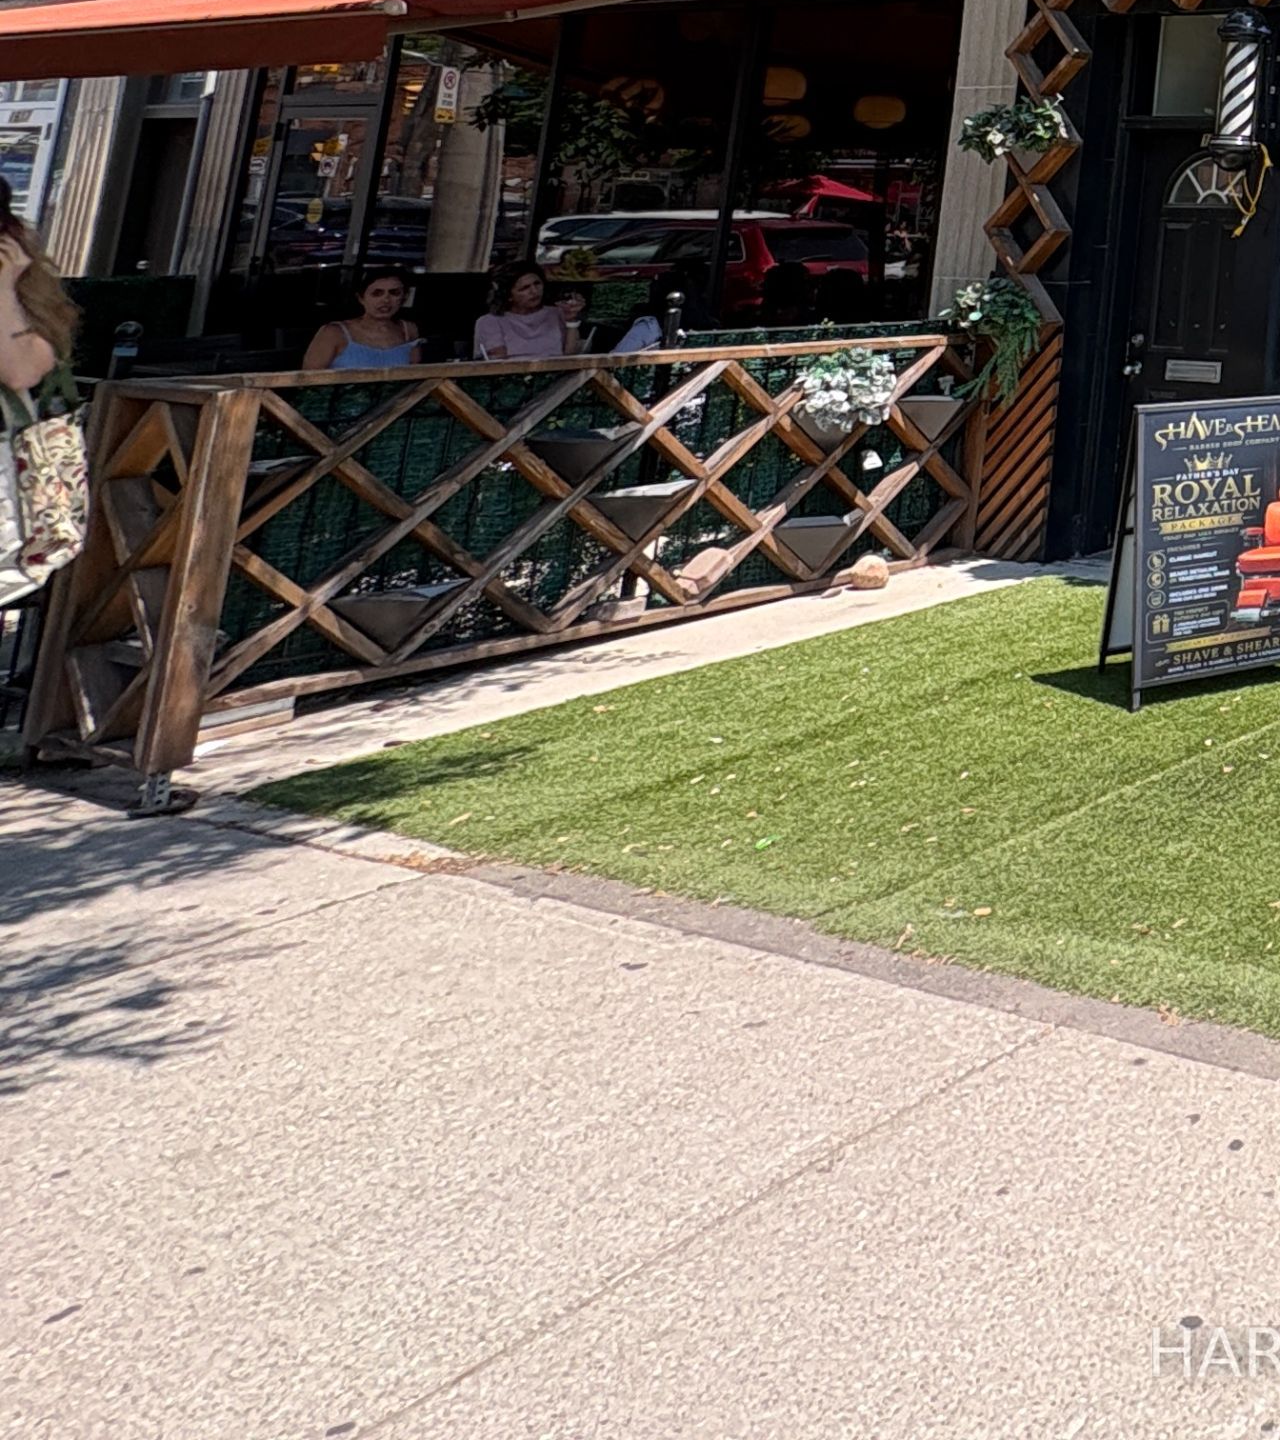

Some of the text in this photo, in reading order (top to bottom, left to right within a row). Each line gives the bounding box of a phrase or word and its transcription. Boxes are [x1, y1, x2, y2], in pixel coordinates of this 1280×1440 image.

[1154, 411, 1227, 451] SHAVE
[1222, 468, 1240, 476] DAY
[1152, 474, 1261, 509] ROYAL
[1151, 496, 1261, 522] RELAXATION
[1170, 517, 1236, 531] PACKAGE
[1173, 648, 1219, 665] SHAVE
[1223, 646, 1233, 656] &
